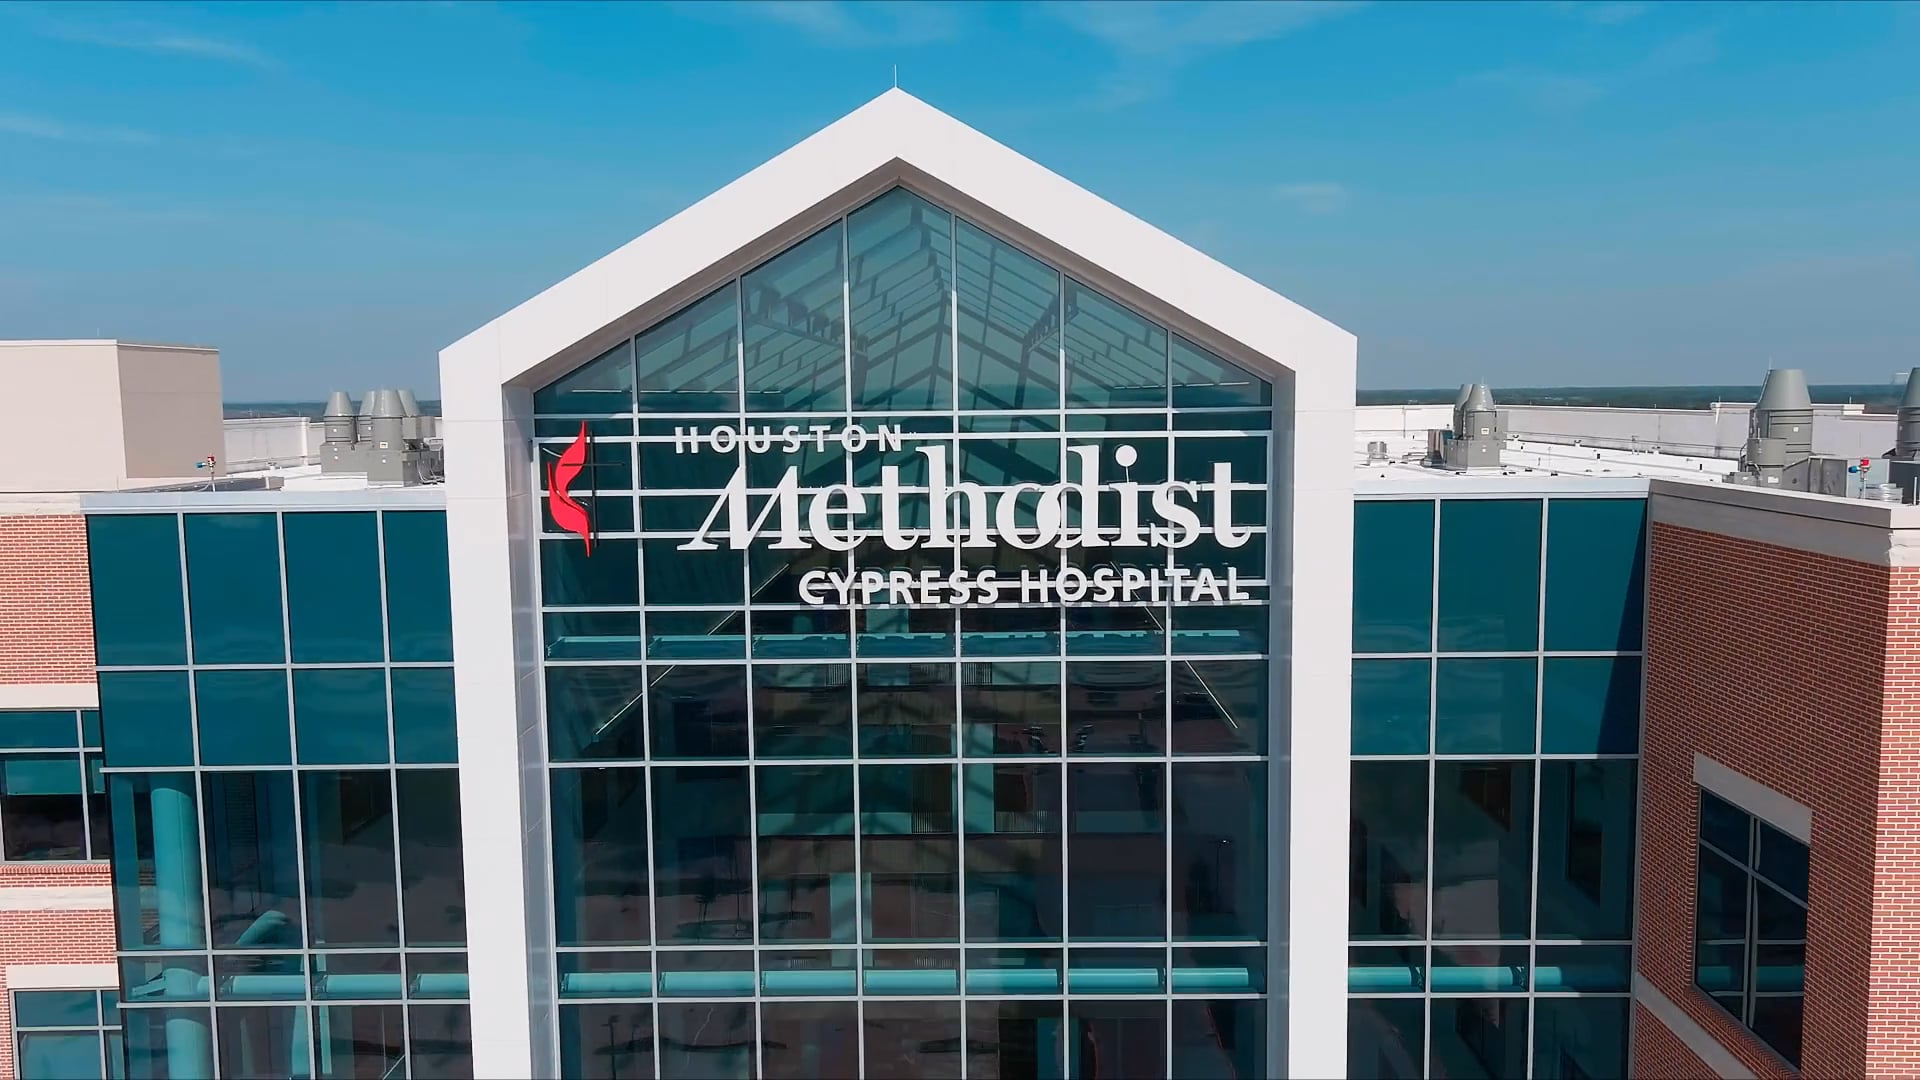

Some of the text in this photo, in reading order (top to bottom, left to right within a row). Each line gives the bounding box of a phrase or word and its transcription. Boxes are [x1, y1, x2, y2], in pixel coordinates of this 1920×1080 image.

[674, 424, 902, 454] HOUSTON
[677, 444, 1251, 551] Methodist
[799, 566, 1250, 605] CYPRESS HOSPITAL
